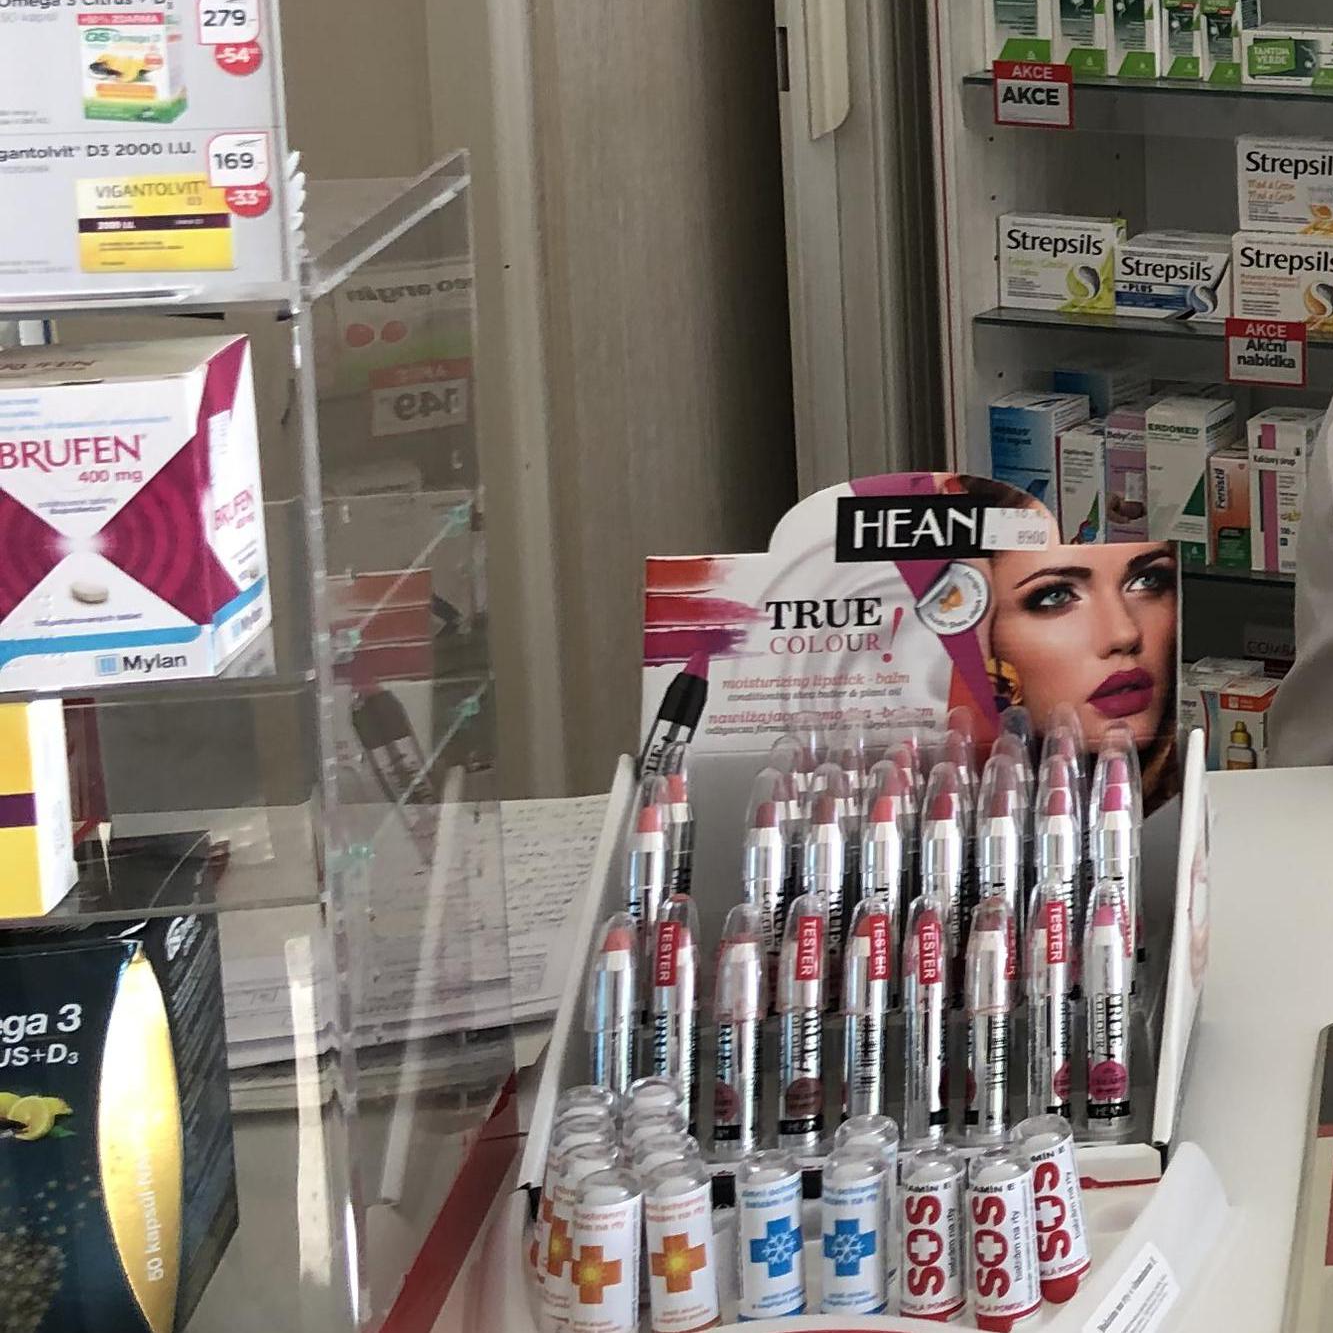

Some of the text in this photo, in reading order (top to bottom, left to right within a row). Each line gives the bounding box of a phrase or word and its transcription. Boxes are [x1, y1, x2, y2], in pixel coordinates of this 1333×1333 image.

[203, 9, 247, 26] 279
[1011, 65, 1053, 79] AKCE
[1001, 86, 1060, 106] AKCE
[87, 144, 111, 158] D3
[114, 142, 163, 157] 2000
[213, 152, 254, 170] 169
[95, 181, 204, 199] VIGANTOLVIT
[1006, 228, 1104, 258] Strepsils
[1120, 256, 1213, 286] Strepsils
[1237, 352, 1297, 370] nabídka
[1245, 338, 1288, 355] Akční
[0, 433, 142, 473] BRUFEN
[78, 469, 143, 485] 400 mg
[854, 507, 979, 549] HEAN
[766, 598, 883, 630] TRUE
[123, 653, 188, 673] Mylan
[870, 916, 888, 977] TESTER
[1048, 903, 1065, 962] TESTER
[656, 924, 672, 983] TESTER
[800, 919, 818, 978] TESTER
[921, 922, 938, 982] TESTER
[57, 1003, 82, 1033] 3
[1034, 1161, 1072, 1263] SOS
[905, 1194, 945, 1297] SOS
[972, 1195, 1011, 1299] SOS
